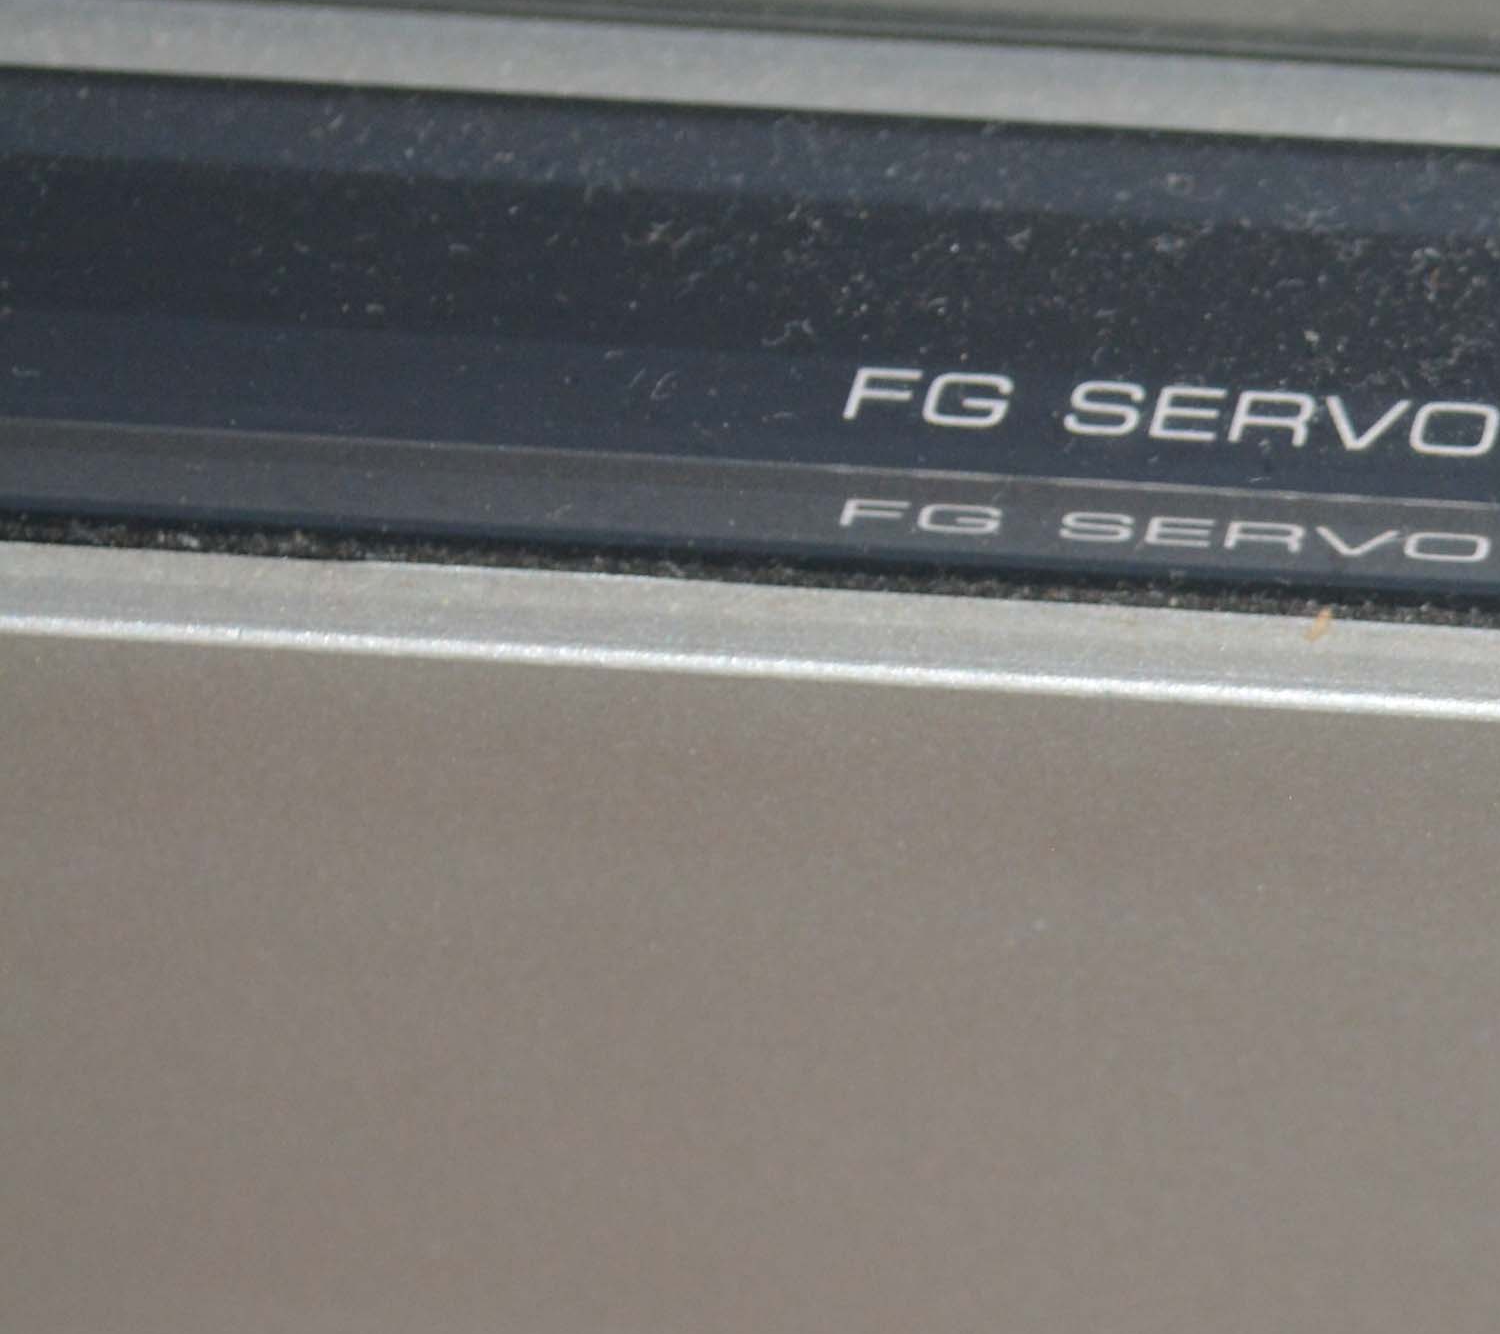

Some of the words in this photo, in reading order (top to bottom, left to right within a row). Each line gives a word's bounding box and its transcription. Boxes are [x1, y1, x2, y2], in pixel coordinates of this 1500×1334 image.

[841, 365, 1013, 429] FG
[838, 497, 1003, 536] FG
[1058, 510, 1493, 564] SERVO
